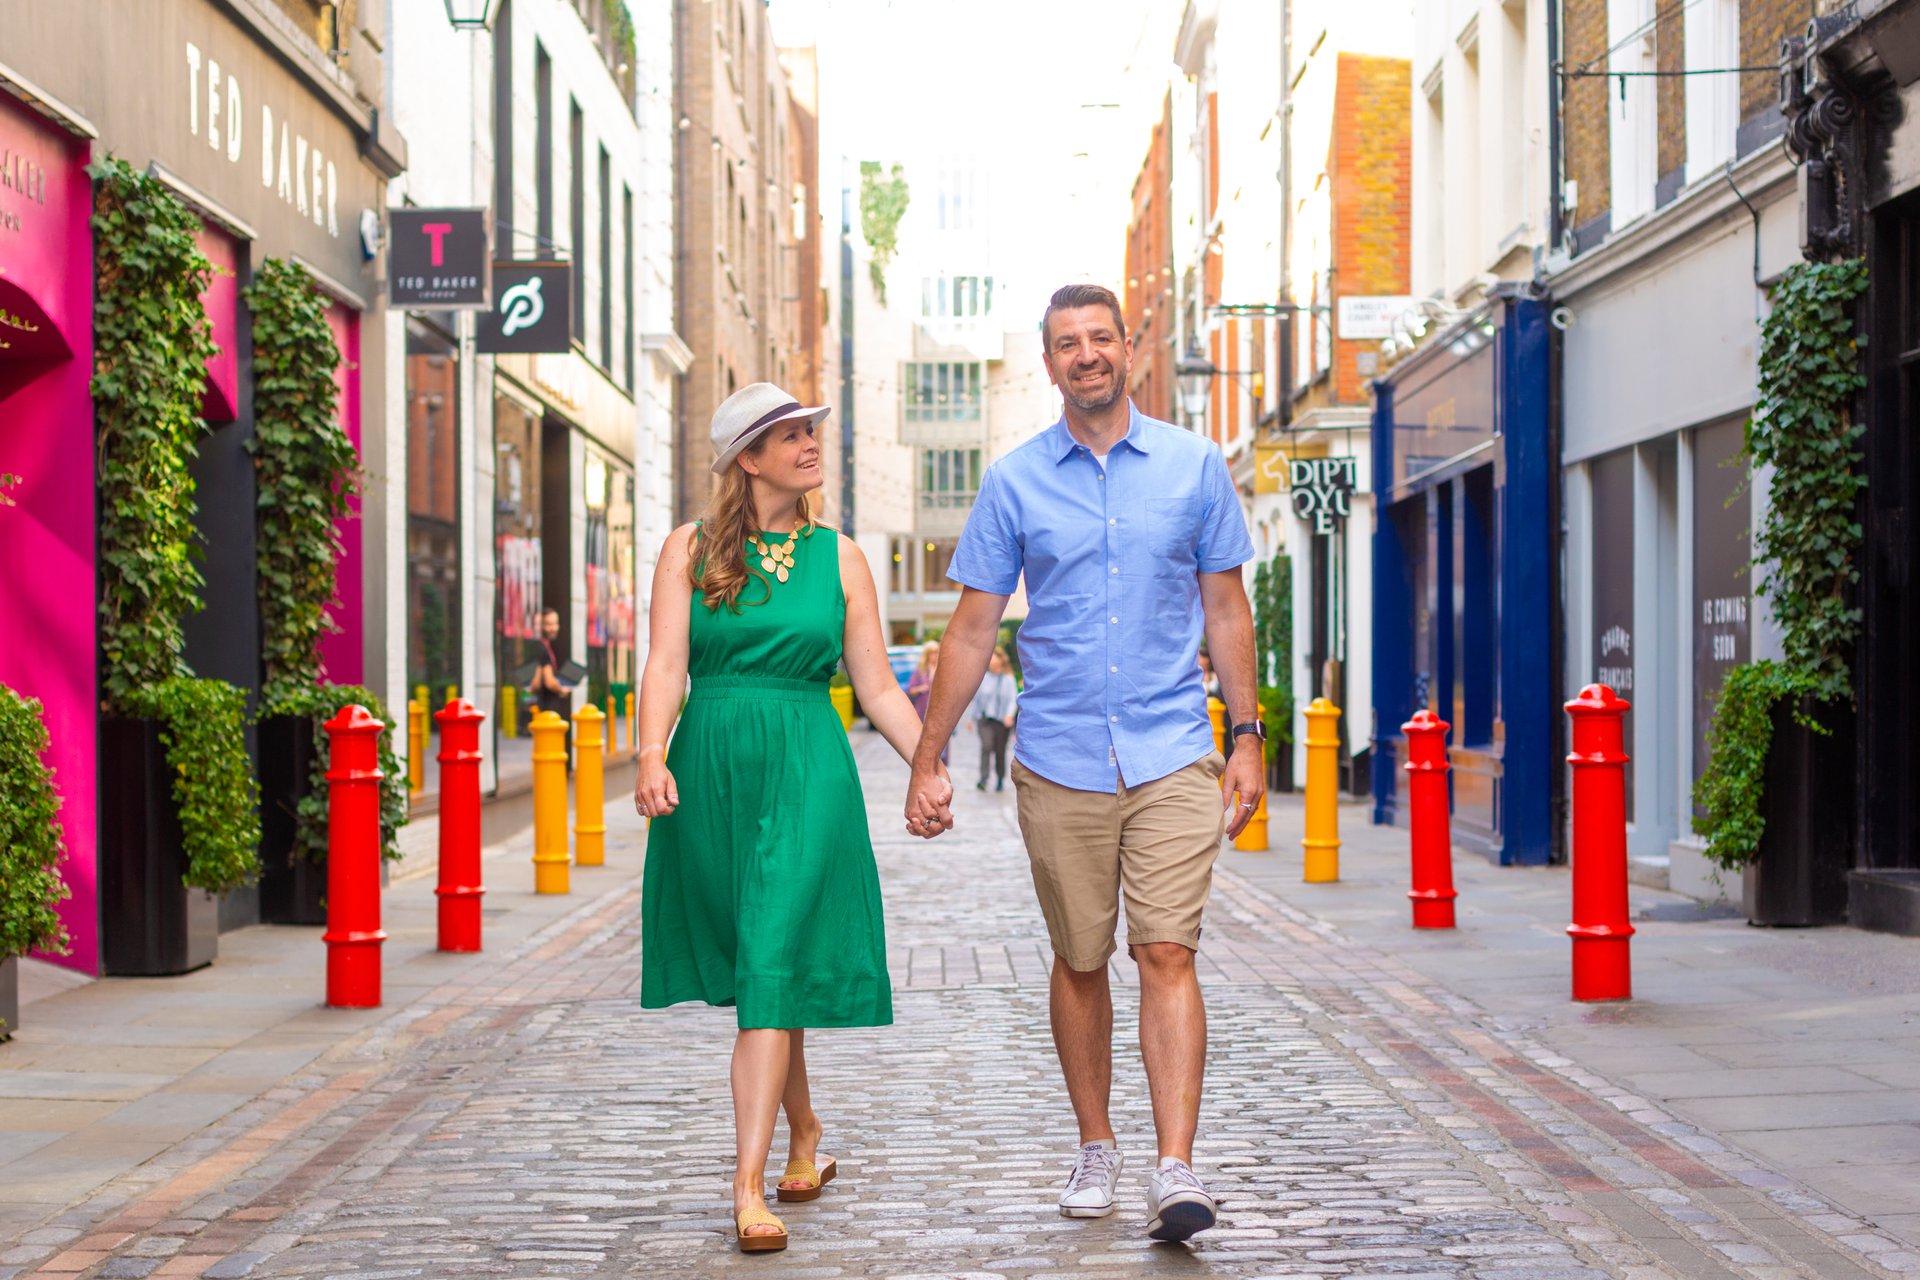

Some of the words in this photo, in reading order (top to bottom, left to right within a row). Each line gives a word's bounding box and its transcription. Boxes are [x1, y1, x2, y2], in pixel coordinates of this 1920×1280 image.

[186, 41, 242, 163] TED
[261, 104, 339, 238] BAKER
[422, 223, 453, 267] T
[398, 276, 425, 290] TED
[432, 276, 478, 289] BAKER
[1291, 459, 1356, 486] DIPT
[1316, 508, 1336, 535] E
[1703, 599, 1713, 625] IS
[1714, 595, 1747, 624] COMING
[1713, 635, 1736, 662] SOON
